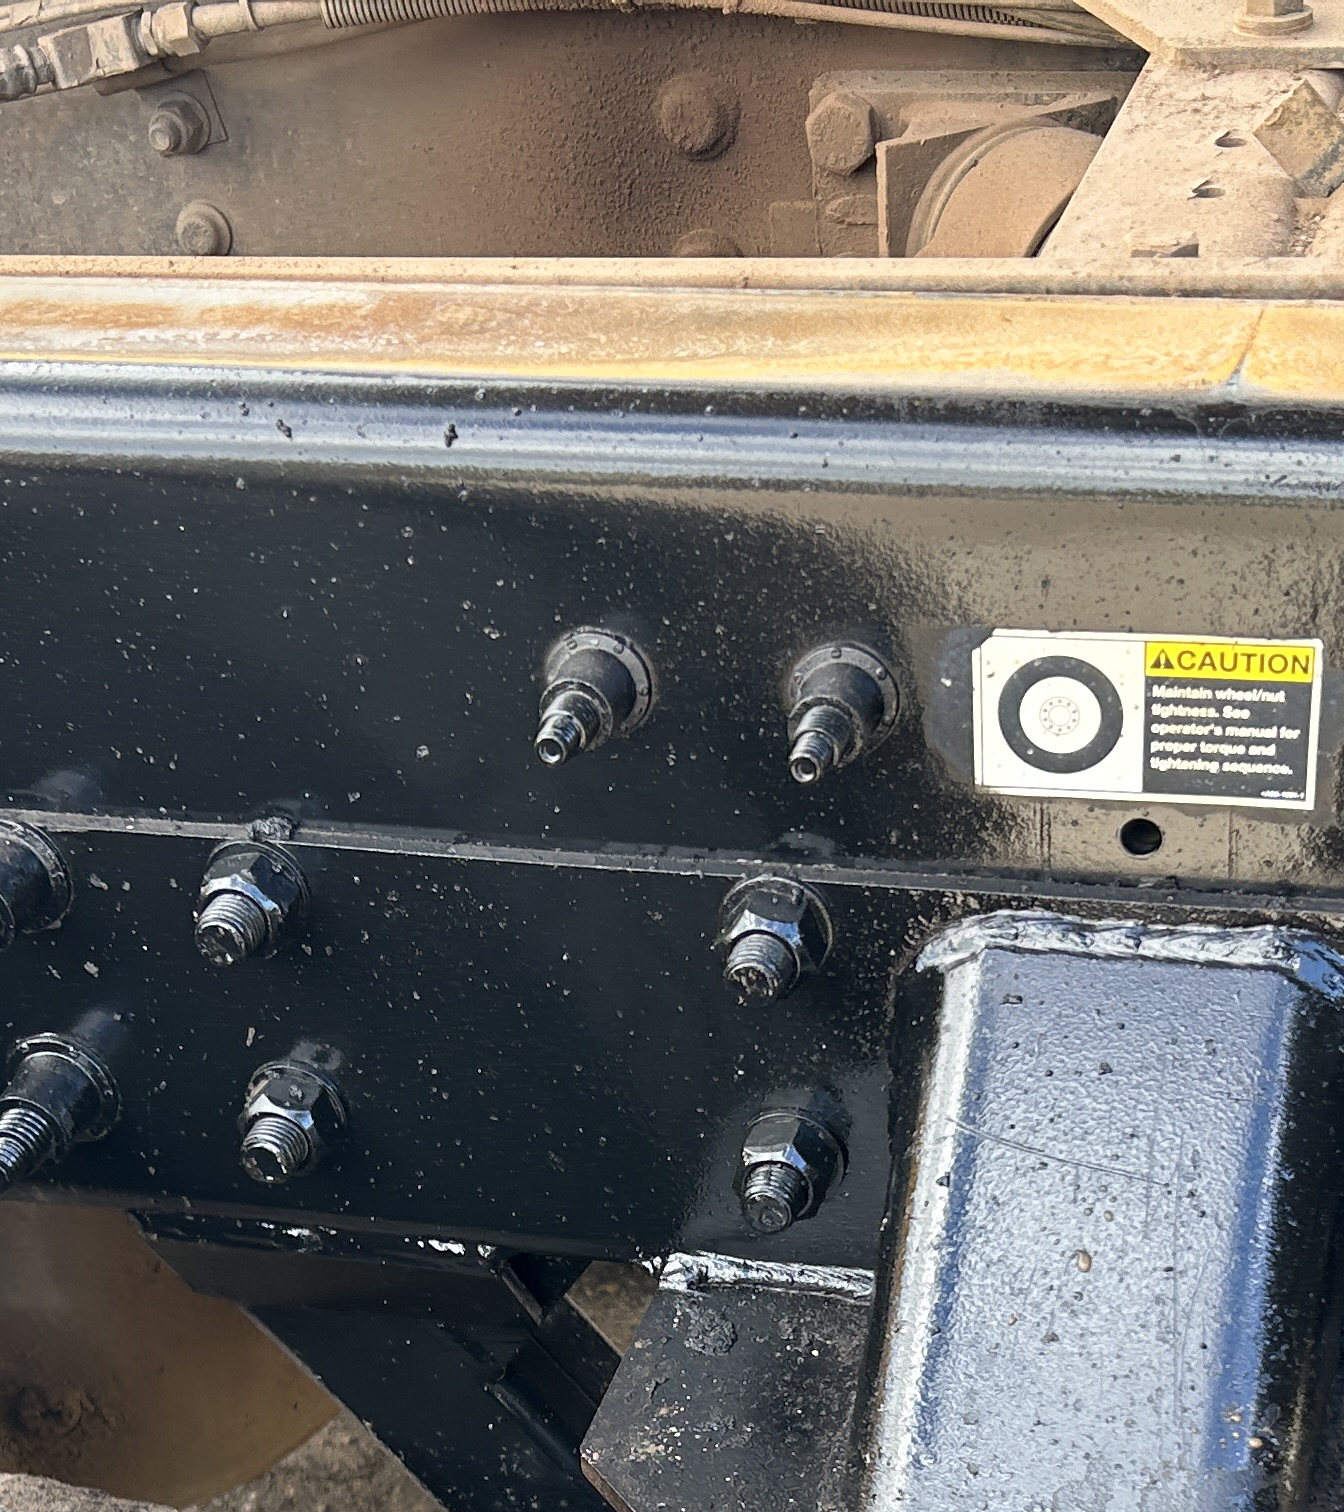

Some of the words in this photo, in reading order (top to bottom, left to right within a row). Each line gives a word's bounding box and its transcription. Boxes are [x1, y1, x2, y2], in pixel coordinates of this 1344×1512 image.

[1177, 650, 1310, 675] CAUTION
[1152, 685, 1213, 700] Maintain
[1214, 687, 1286, 703] wheel/nut
[1151, 703, 1219, 719] tightness.
[1222, 705, 1251, 720] See
[1151, 723, 1223, 737] operator's
[1225, 725, 1278, 739] manual
[1279, 726, 1301, 740] for
[1150, 741, 1197, 754] proper
[1199, 741, 1246, 756] torque
[1248, 743, 1276, 757] and
[1150, 756, 1220, 774] tightening
[1222, 761, 1294, 775] sequence.
